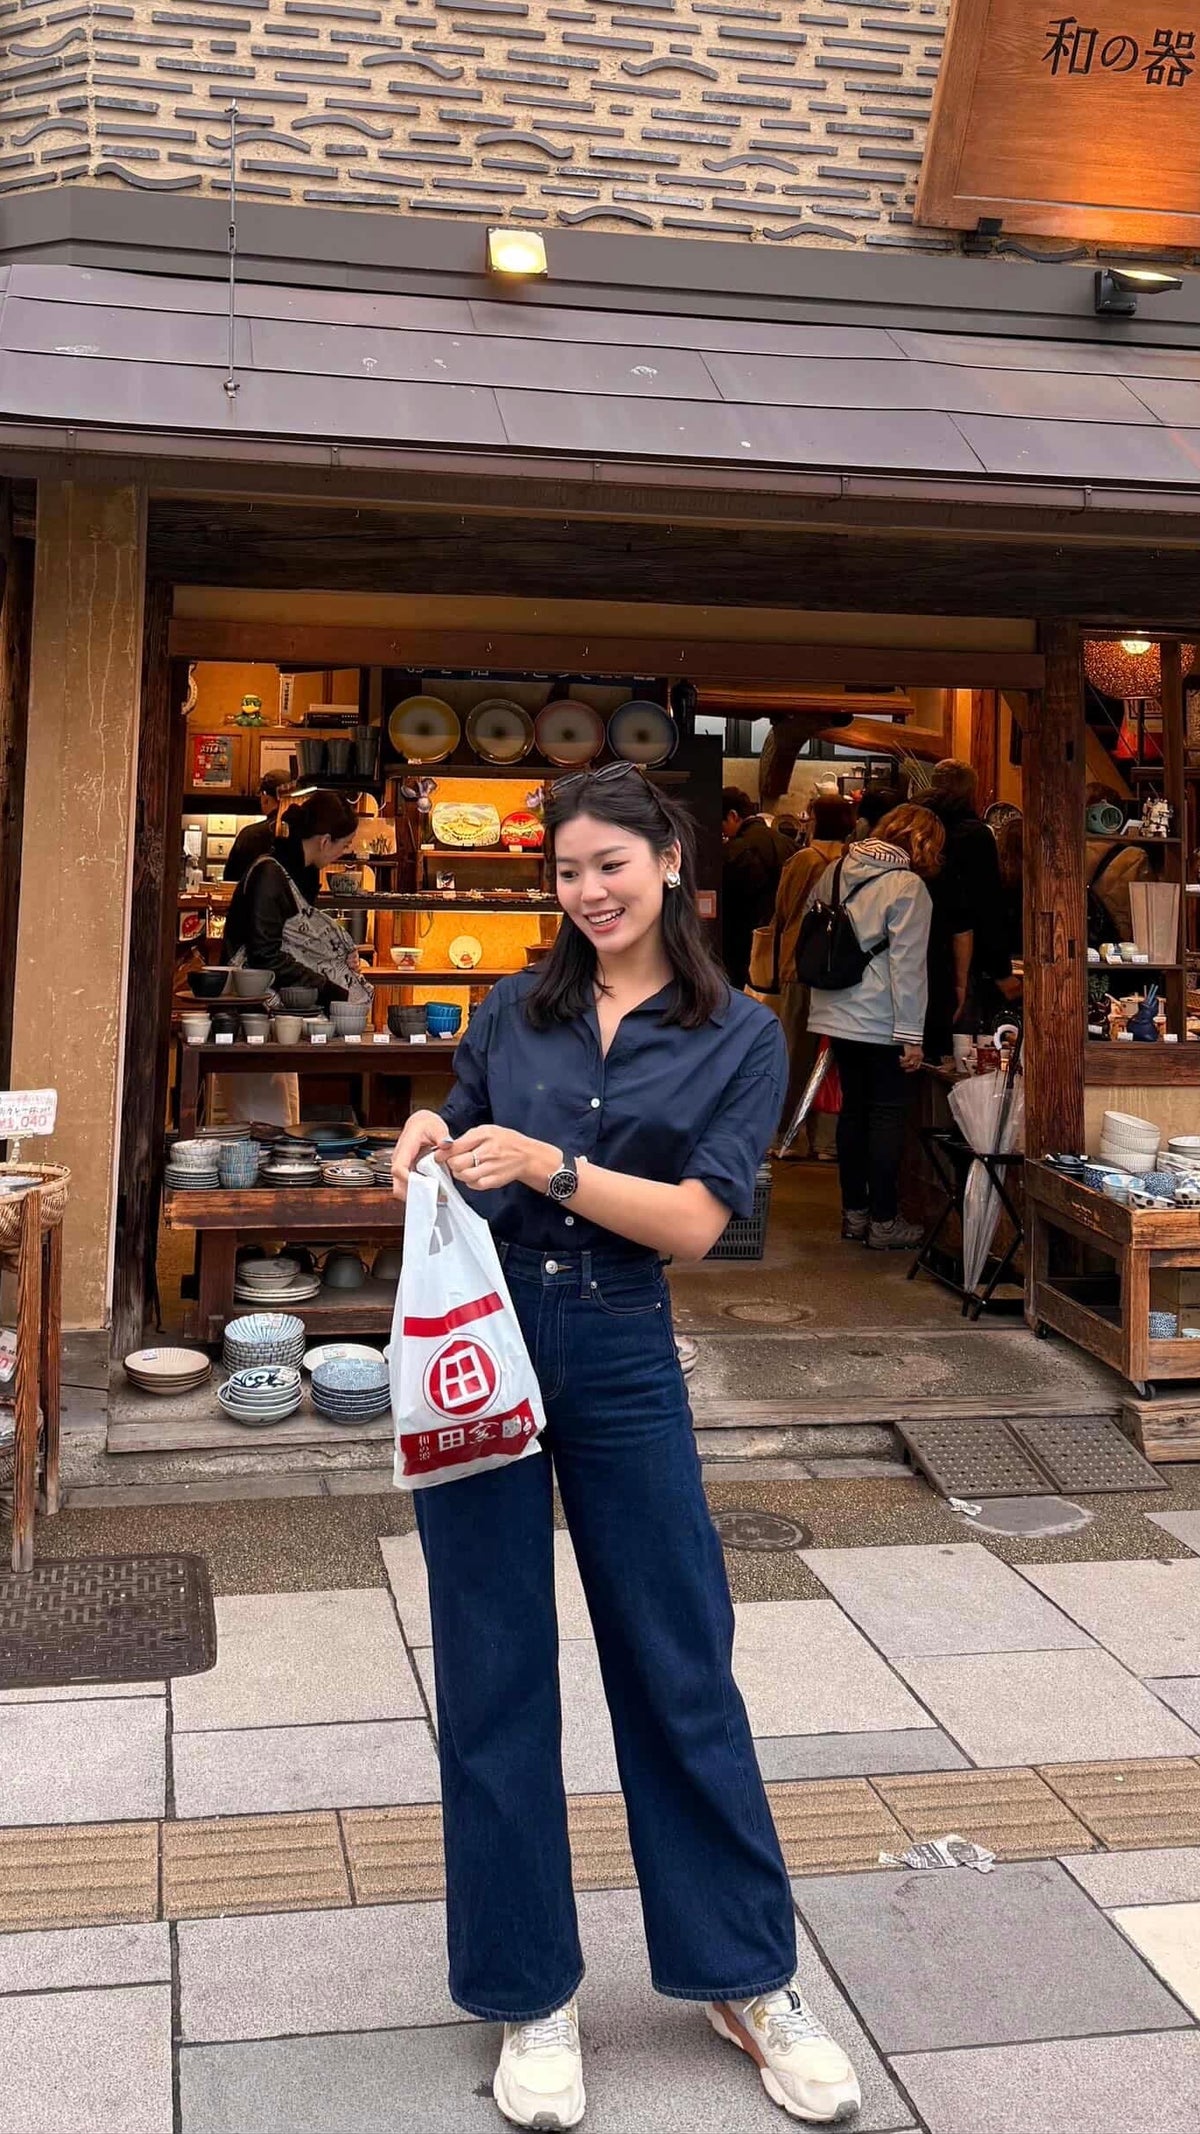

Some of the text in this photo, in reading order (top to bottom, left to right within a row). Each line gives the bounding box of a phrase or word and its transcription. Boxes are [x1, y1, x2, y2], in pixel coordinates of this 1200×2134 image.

[1042, 16, 1196, 87] 和の器
[439, 1346, 490, 1409] 田
